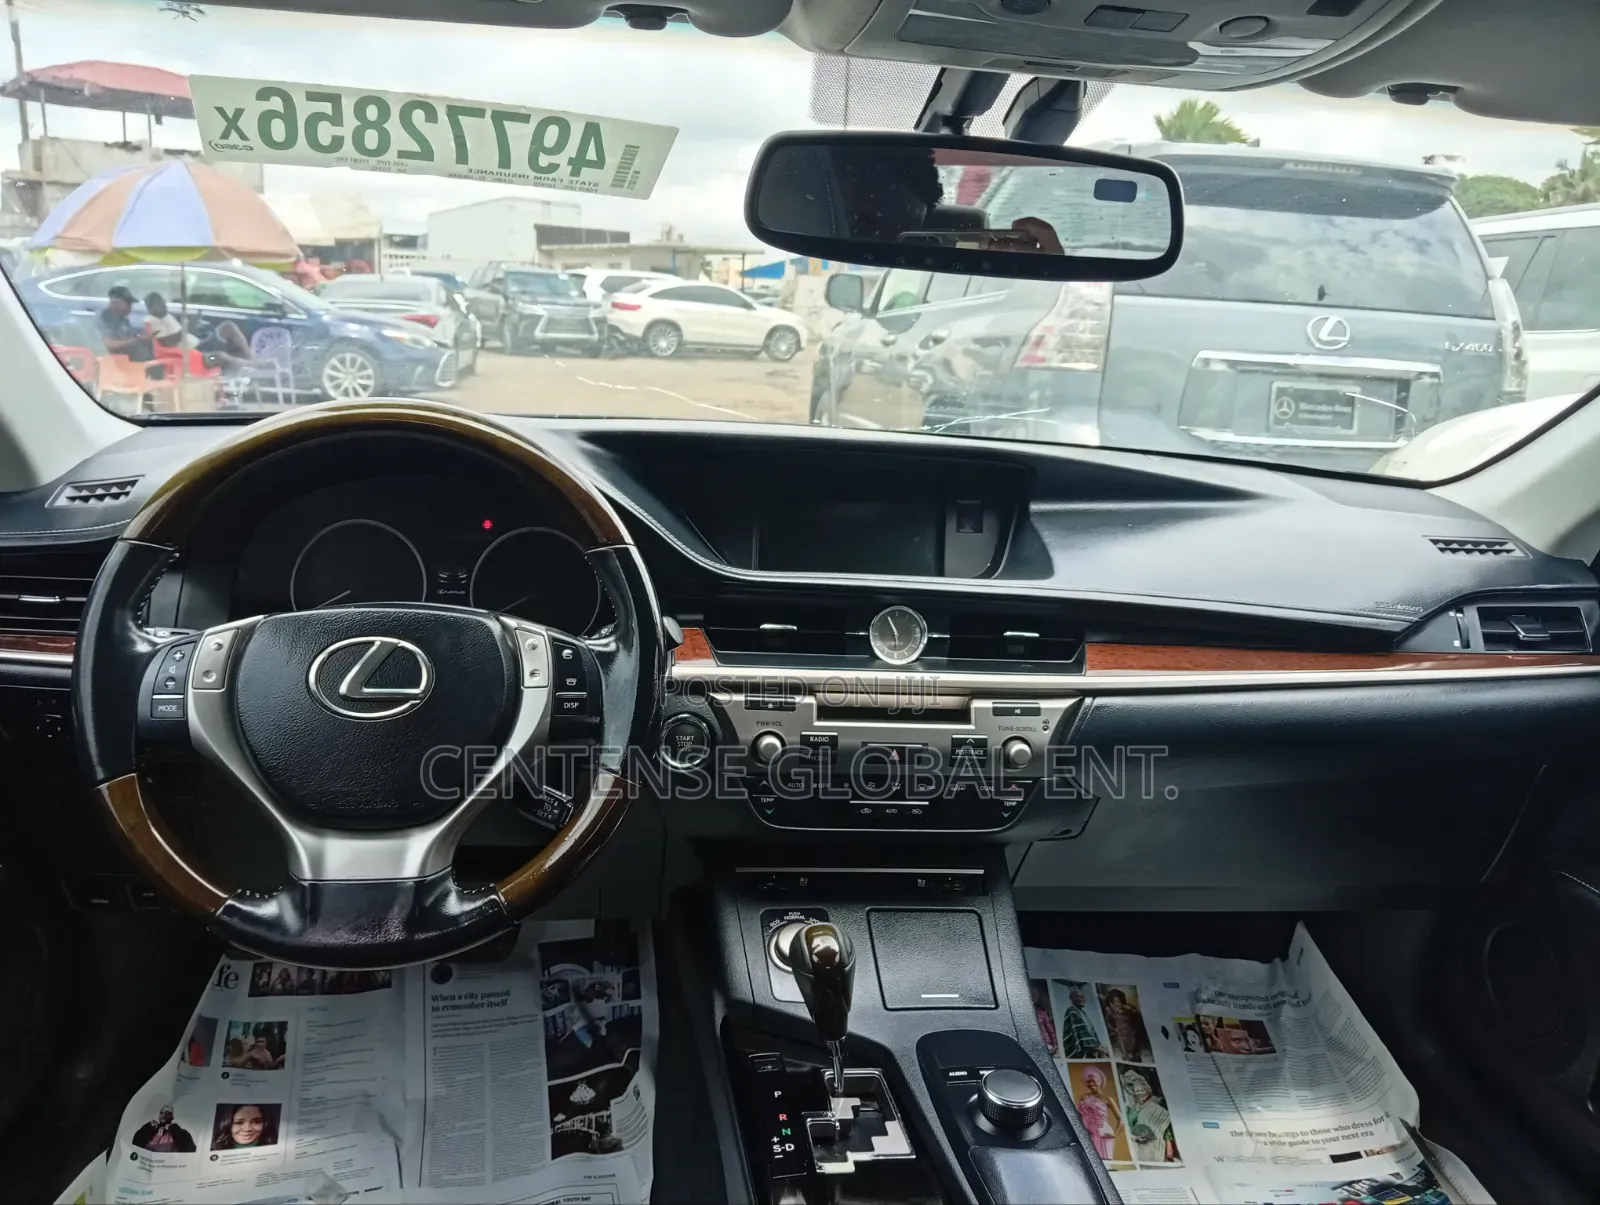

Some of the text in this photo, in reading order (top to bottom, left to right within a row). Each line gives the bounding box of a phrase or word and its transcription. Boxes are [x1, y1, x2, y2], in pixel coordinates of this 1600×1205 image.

[769, 919, 781, 927] ECO
[779, 1113, 788, 1121] R
[782, 1127, 791, 1135] N
[1230, 1130, 1244, 1138] The
[1300, 1129, 1308, 1137] to
[1309, 1127, 1330, 1137] those
[1332, 1124, 1350, 1133] who
[1351, 1120, 1373, 1130] dress
[1373, 1116, 1385, 1126] for
[1288, 1138, 1310, 1148] guide
[1311, 1137, 1321, 1145] to
[1321, 1136, 1341, 1145] your
[1341, 1132, 1360, 1141] next
